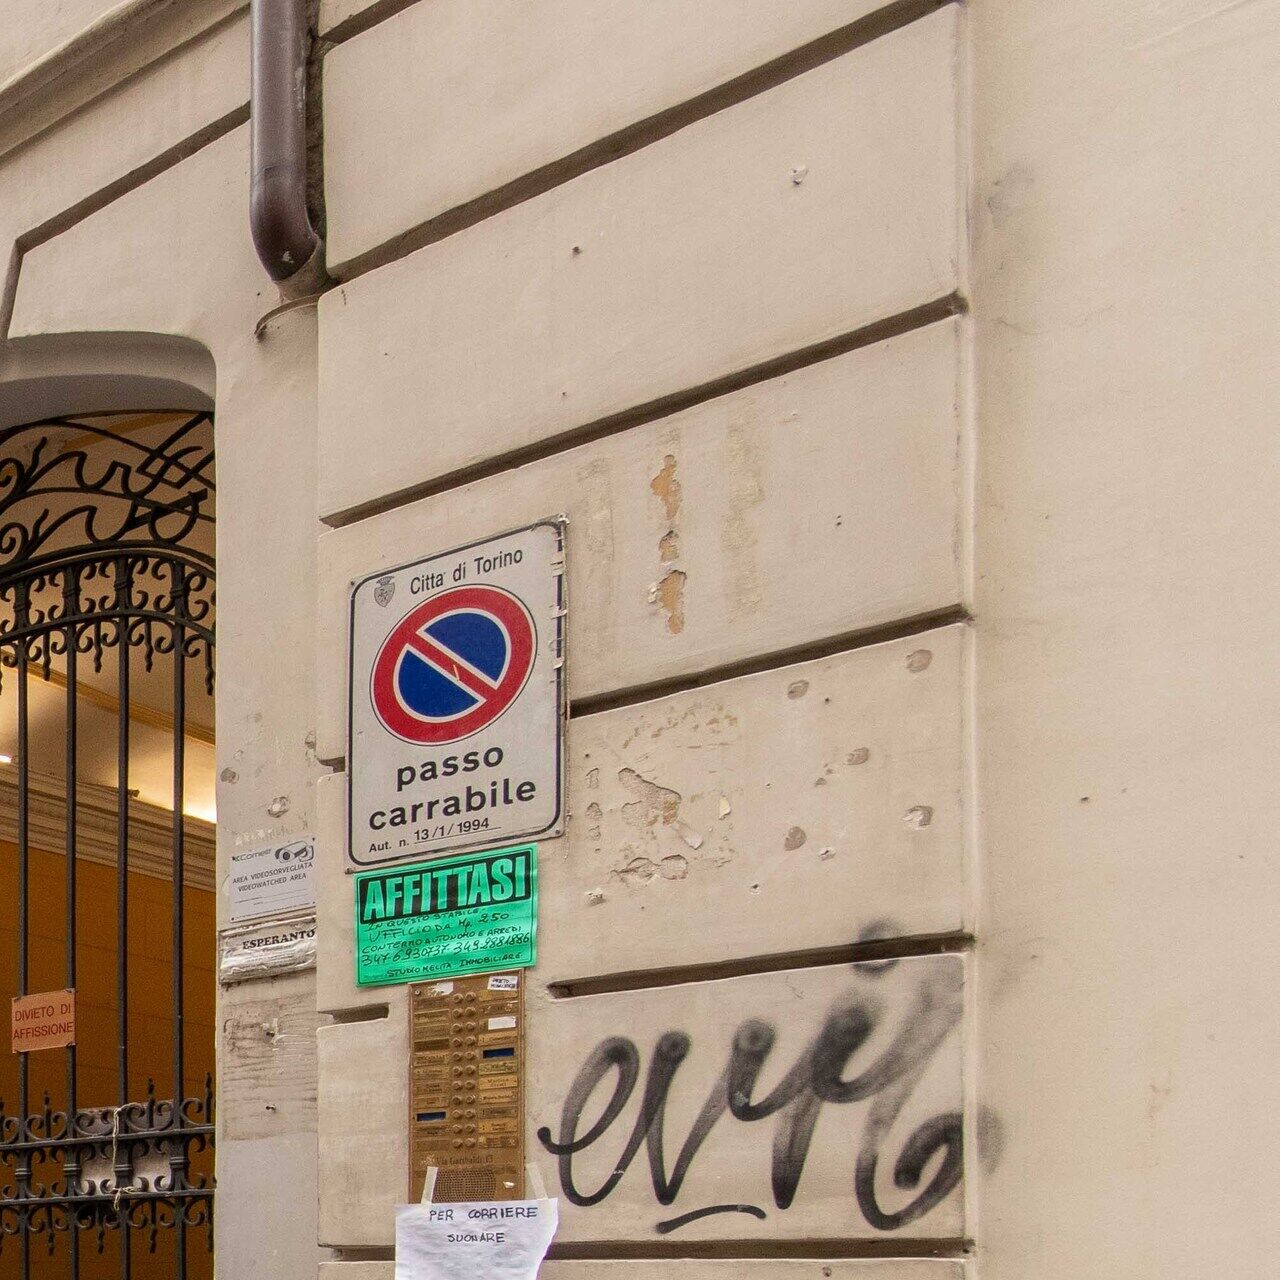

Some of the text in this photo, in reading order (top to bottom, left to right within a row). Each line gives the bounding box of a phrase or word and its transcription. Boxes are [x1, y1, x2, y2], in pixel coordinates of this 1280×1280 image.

[453, 562, 467, 582] di
[474, 549, 523, 575] Torino
[396, 747, 504, 792] passo
[369, 778, 536, 830] carrabile
[369, 840, 392, 853] Aut.
[399, 837, 410, 848] n.
[233, 862, 313, 884] AREA VIDEOSORVEGLIATA
[238, 873, 307, 892] VIDEOWATCHED AREA
[364, 856, 526, 921] AFFITTASI
[478, 913, 509, 923] 250
[242, 928, 316, 950] ESPERANTO
[14, 1003, 71, 1022] DIVIETO DI
[13, 1022, 74, 1040] AFFISSIONE
[429, 1207, 538, 1221] PER CORRIERE
[447, 1232, 505, 1243] SUONARE
